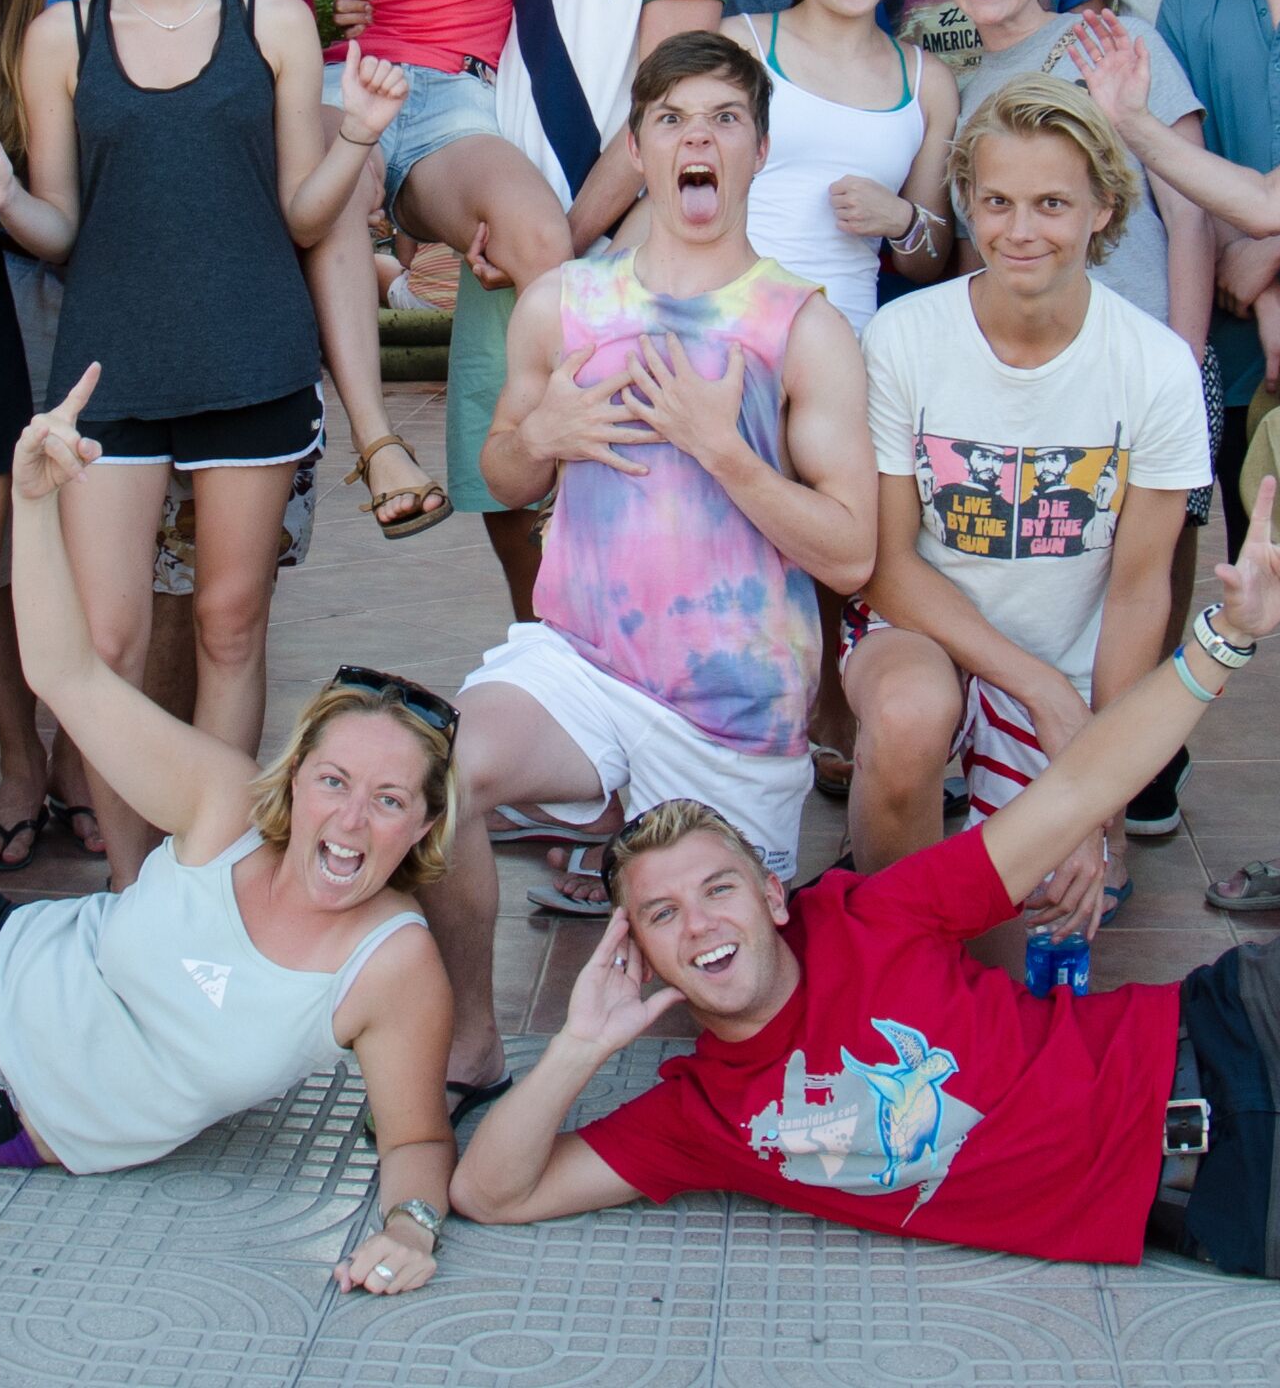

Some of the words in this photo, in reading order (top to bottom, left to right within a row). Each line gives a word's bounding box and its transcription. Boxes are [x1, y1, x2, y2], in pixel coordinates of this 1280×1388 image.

[946, 511, 970, 533] BY
[974, 516, 1008, 538] THE
[1021, 518, 1045, 538] BY
[1050, 518, 1084, 537] THE
[956, 534, 991, 555] GUN
[1030, 537, 1066, 555] GUN
